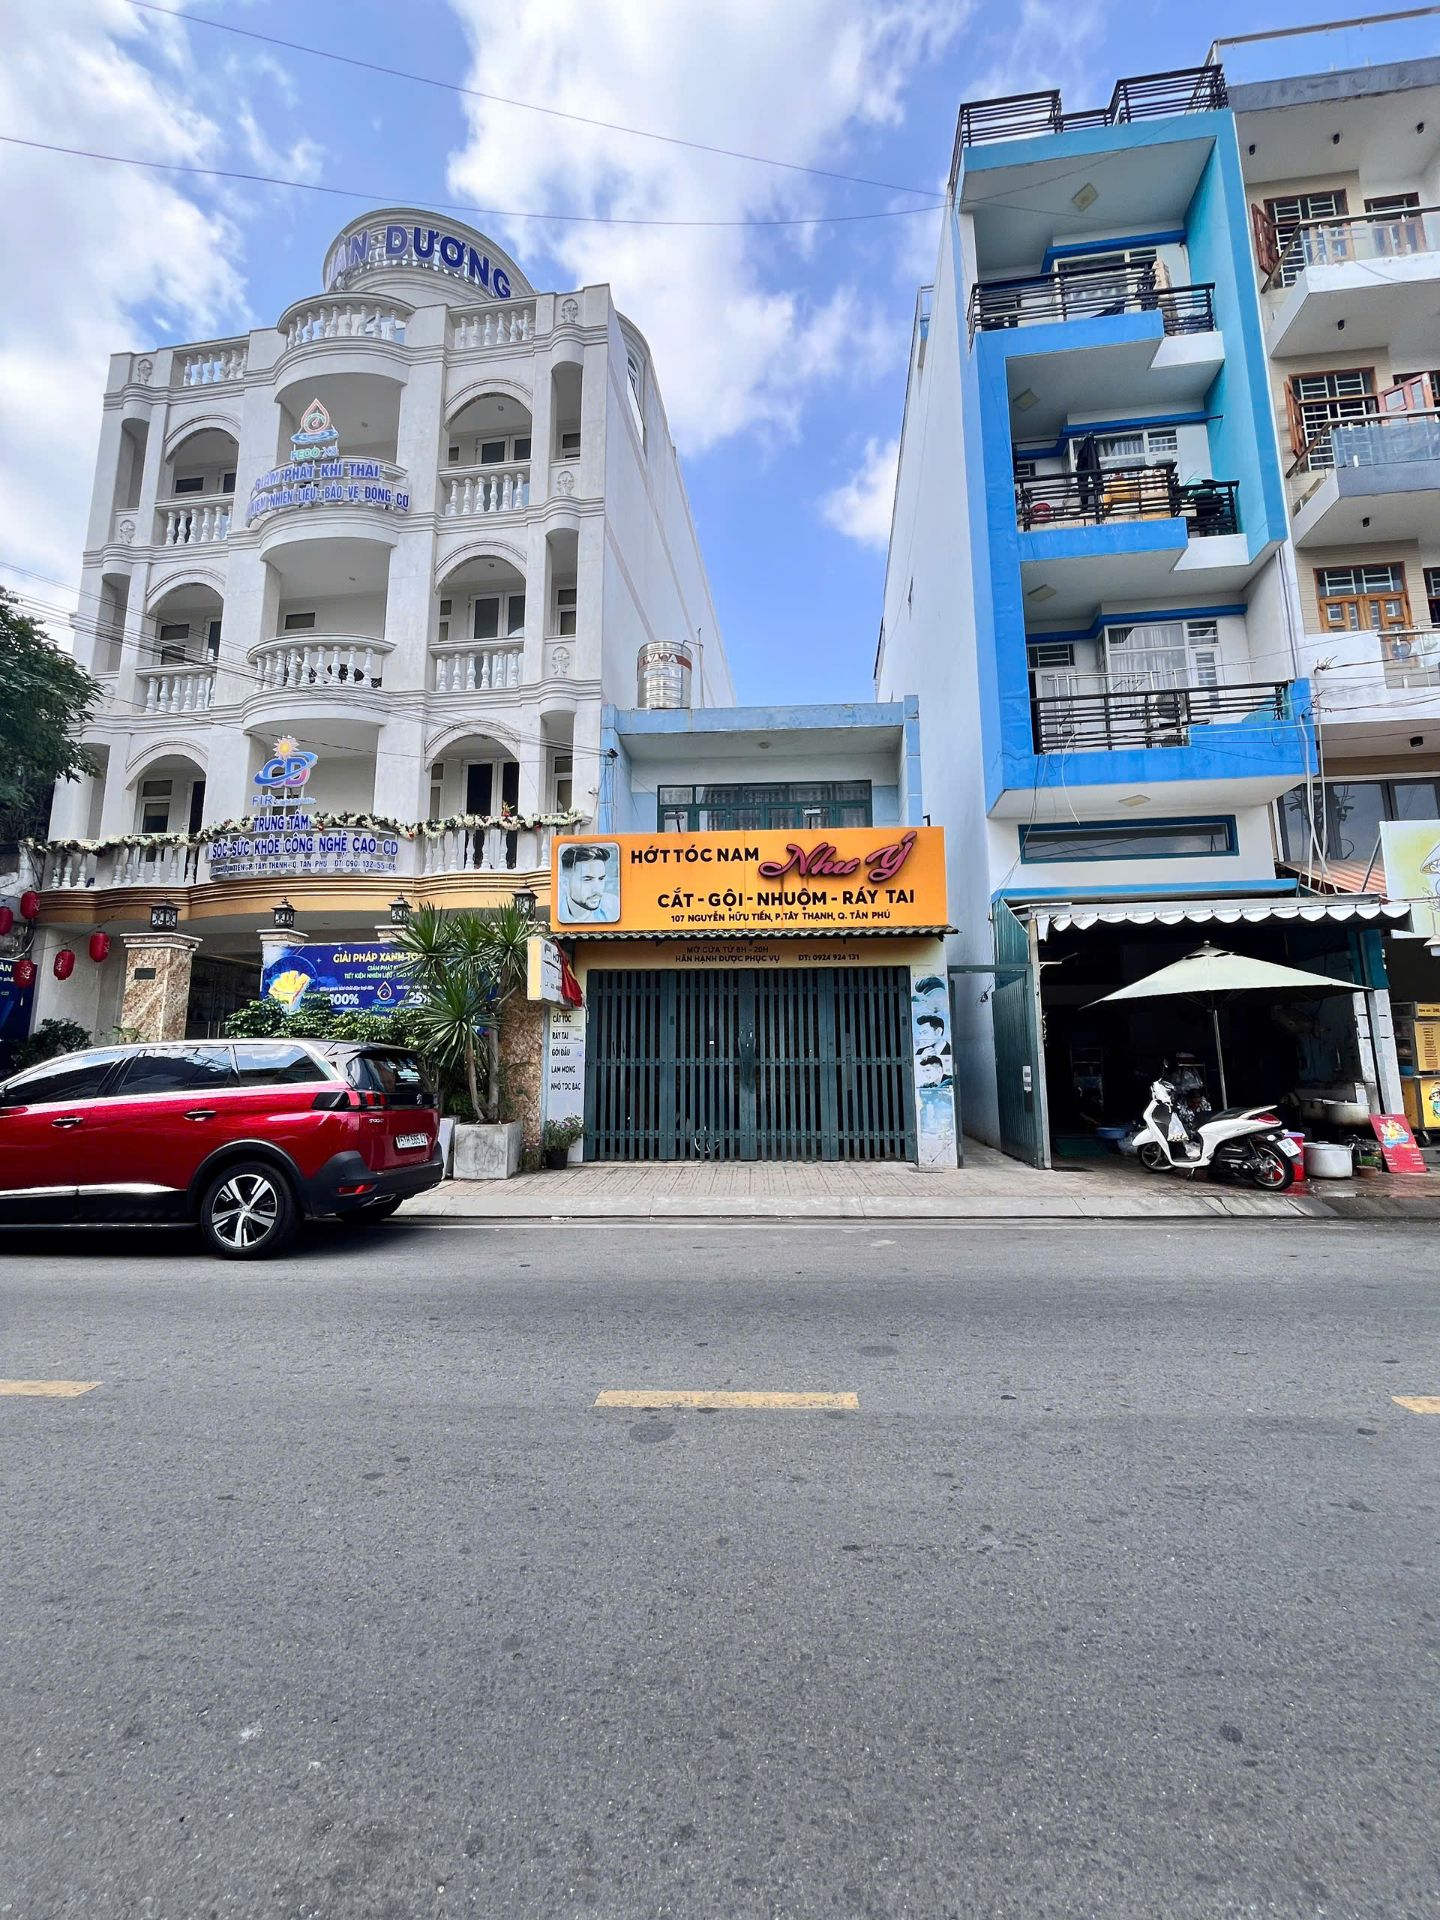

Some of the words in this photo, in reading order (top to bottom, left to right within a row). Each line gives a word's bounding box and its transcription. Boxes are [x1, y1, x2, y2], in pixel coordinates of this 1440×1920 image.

[385, 225, 511, 298] DƯƠNG
[254, 815, 285, 832] TRUNG
[289, 810, 309, 830] TÂM
[284, 833, 313, 853] CÔNG
[318, 832, 348, 856] NGHỆ
[352, 837, 377, 853] CAO
[383, 840, 399, 856] CD
[631, 846, 670, 864] HỚT
[673, 844, 713, 862] TÓC
[717, 847, 759, 862] NAM
[864, 830, 918, 883] Ý
[657, 887, 694, 908] CẮT
[708, 888, 743, 911] GỘI
[757, 887, 827, 911] NHUỘM
[842, 886, 878, 904] RÁY
[885, 889, 914, 904] TAI
[687, 911, 725, 921] NGUYỄN
[728, 911, 749, 921] HỮU
[850, 910, 868, 919] TÂN
[333, 950, 351, 963] GIẢI
[353, 950, 378, 963] PHÁP
